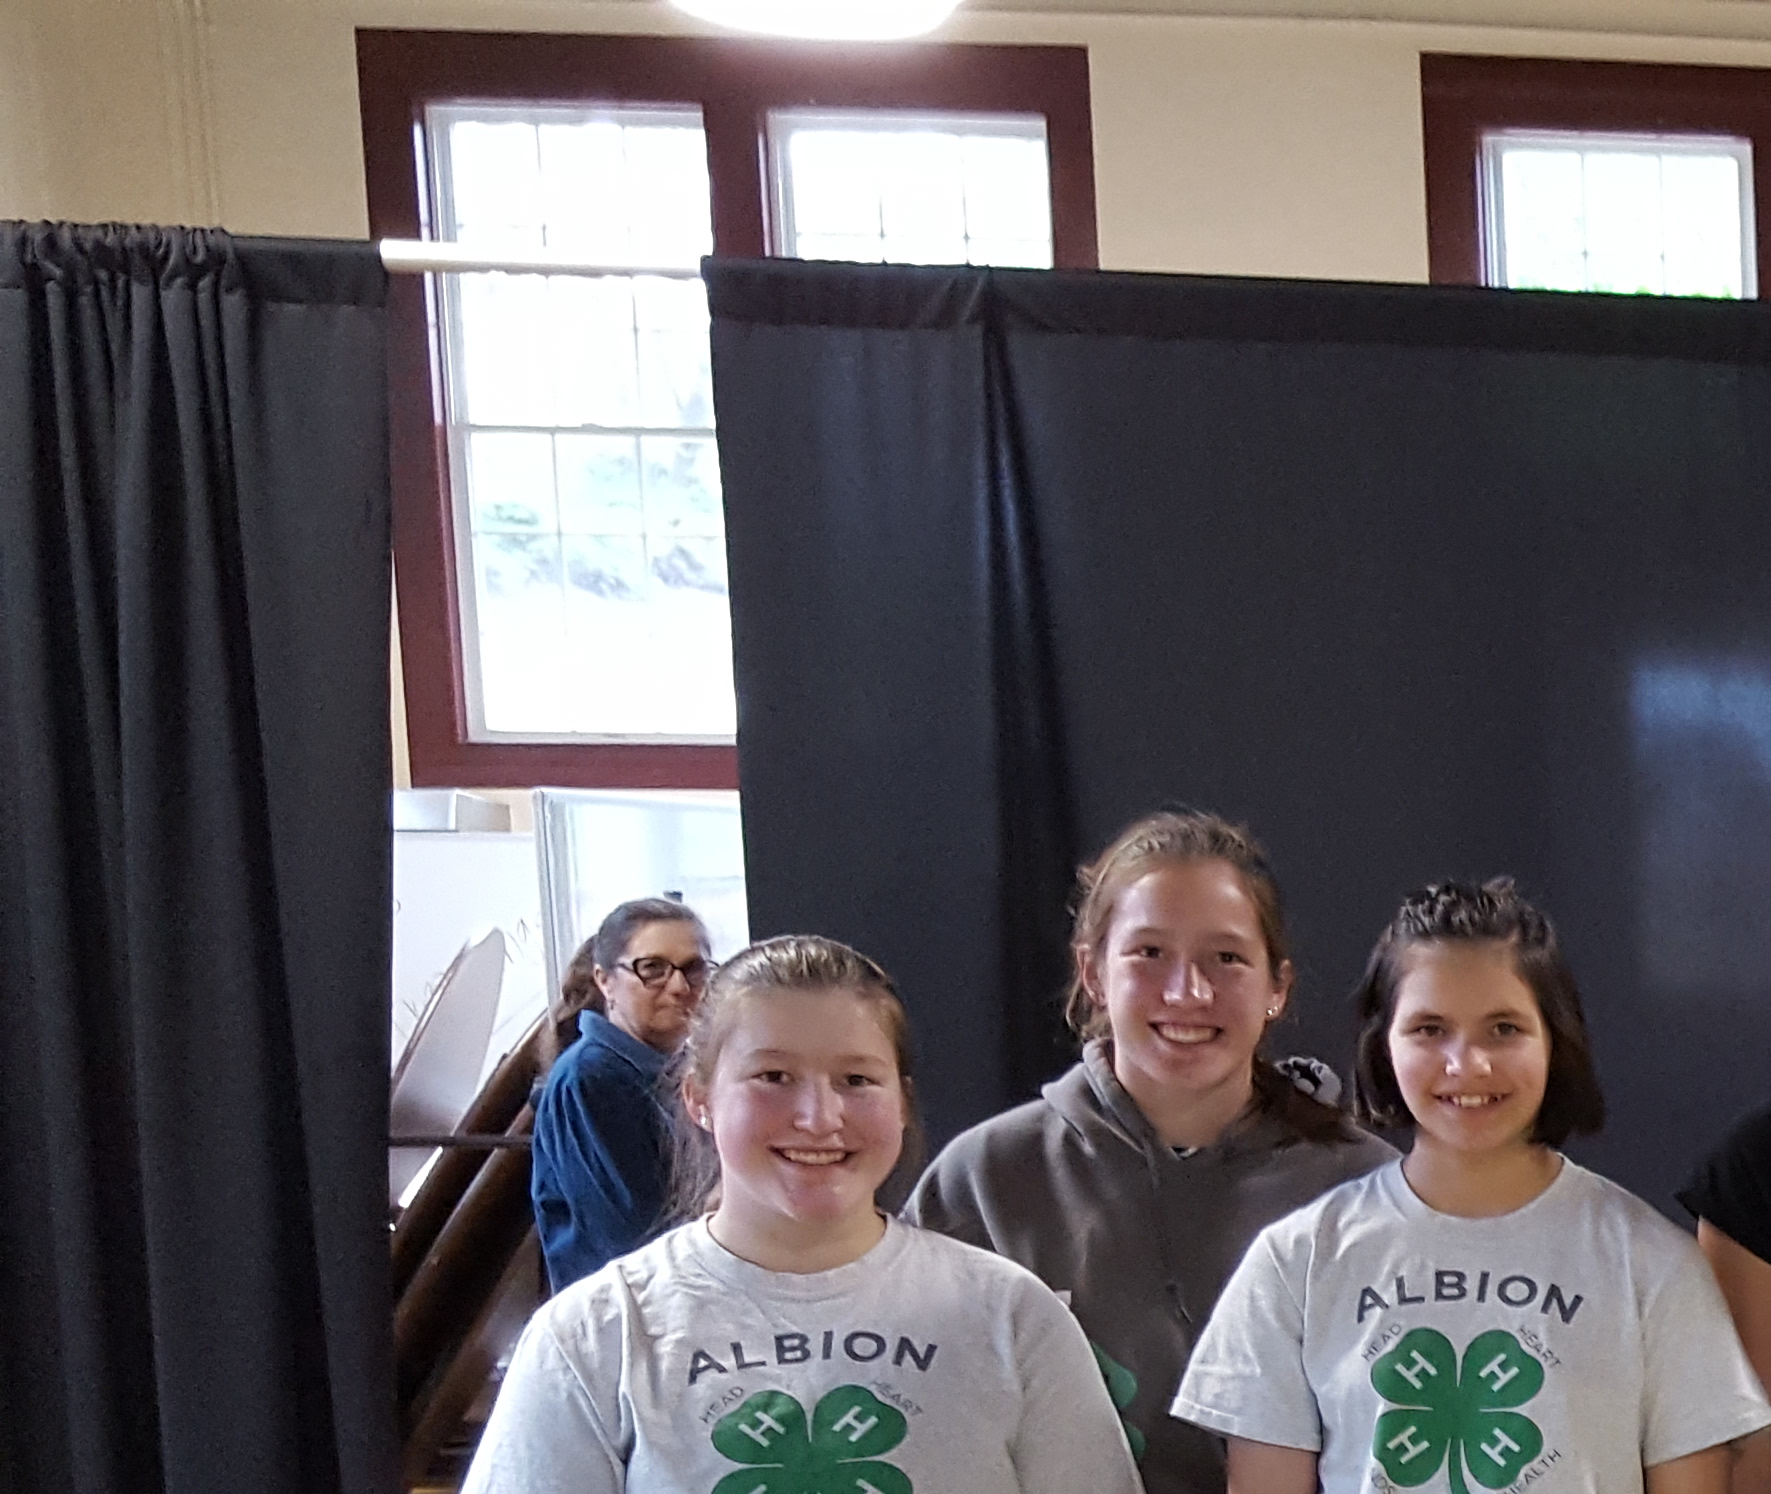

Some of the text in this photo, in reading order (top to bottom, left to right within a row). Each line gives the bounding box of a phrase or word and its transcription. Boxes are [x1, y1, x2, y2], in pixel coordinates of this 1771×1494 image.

[1357, 1270, 1584, 1324] ALBION
[688, 1330, 938, 1385] ALBION
[1361, 1323, 1402, 1362] HEAD
[1517, 1324, 1562, 1369] HEART
[1394, 1350, 1437, 1390] H
[1479, 1353, 1521, 1393] H
[699, 1386, 745, 1424] HEAD
[832, 1405, 879, 1442] H
[738, 1410, 786, 1447] H
[1387, 1425, 1430, 1465] H
[1480, 1427, 1521, 1467] H
